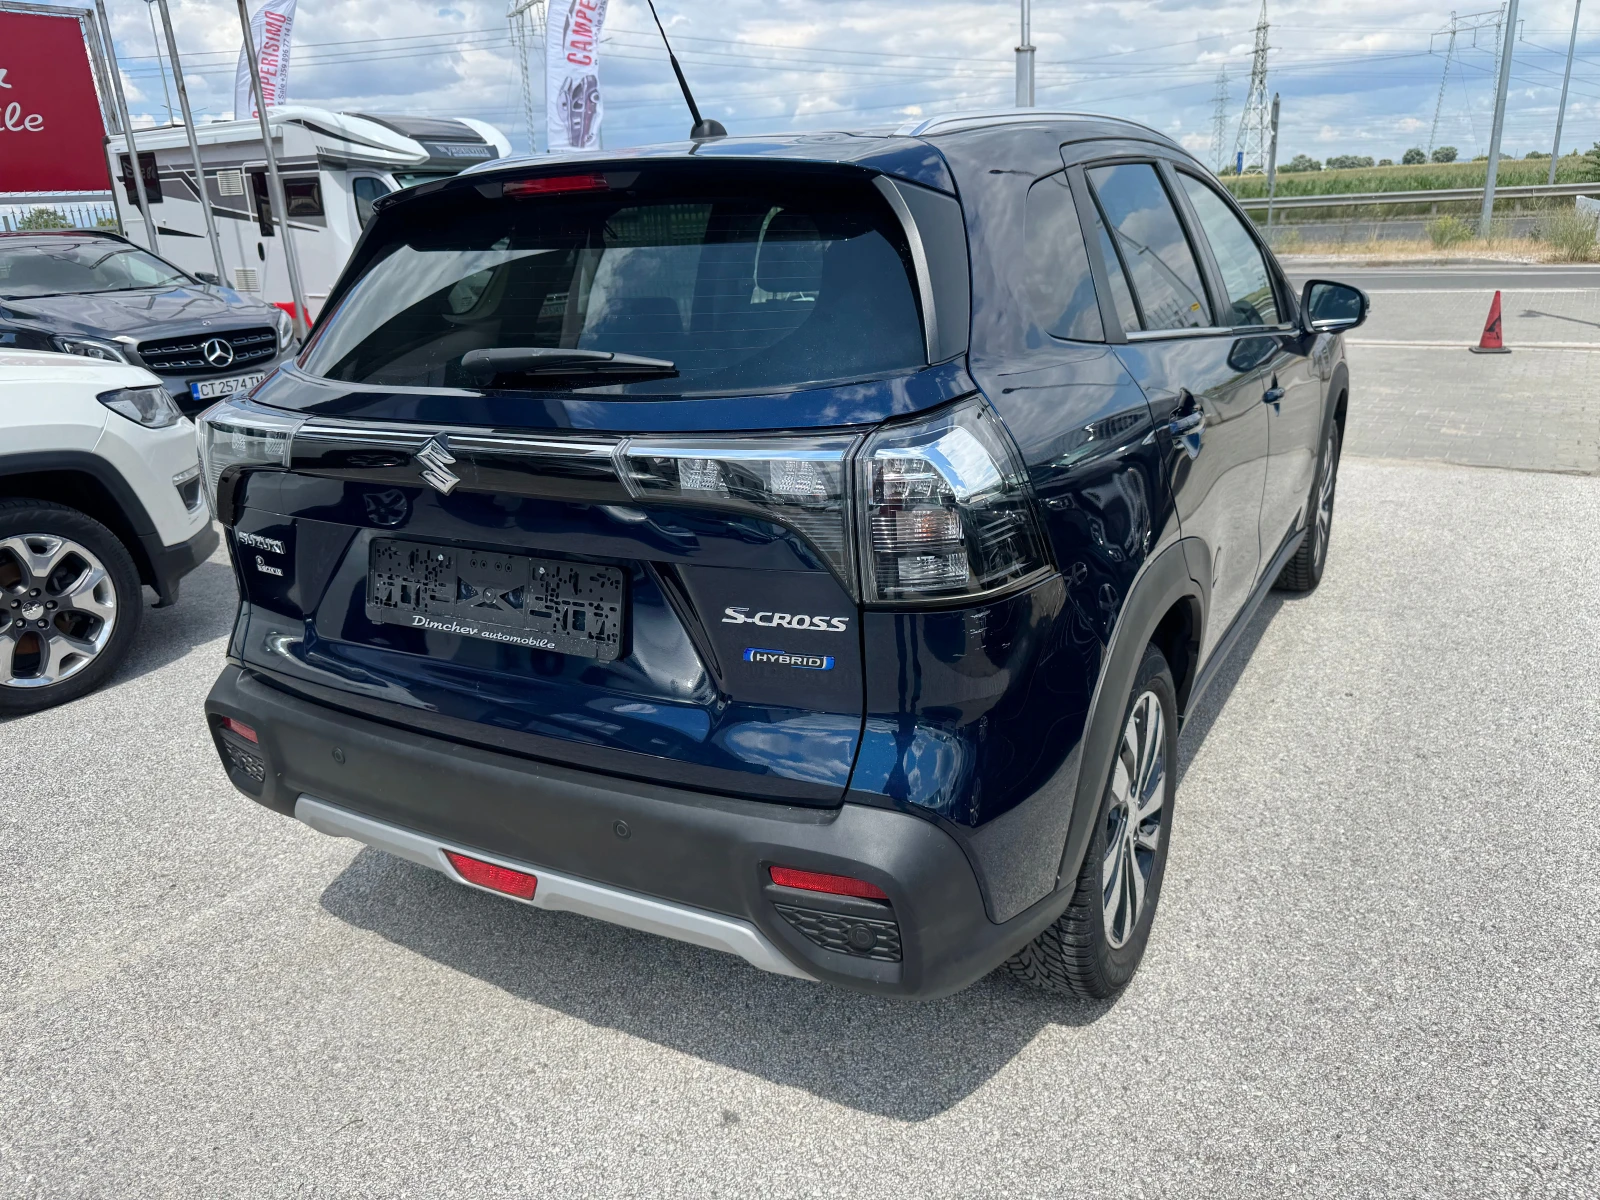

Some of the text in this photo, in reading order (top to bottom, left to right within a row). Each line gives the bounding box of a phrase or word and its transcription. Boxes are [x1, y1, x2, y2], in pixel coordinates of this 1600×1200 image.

[252, 10, 287, 119] MPERISIMO
[278, 83, 286, 99] Sale
[0, 102, 45, 132] le
[200, 382, 216, 396] CT
[219, 378, 247, 394] 2574
[412, 615, 556, 649] Dimchev automobile
[721, 606, 850, 632] S-CROSS
[755, 653, 821, 667] HYBRID
